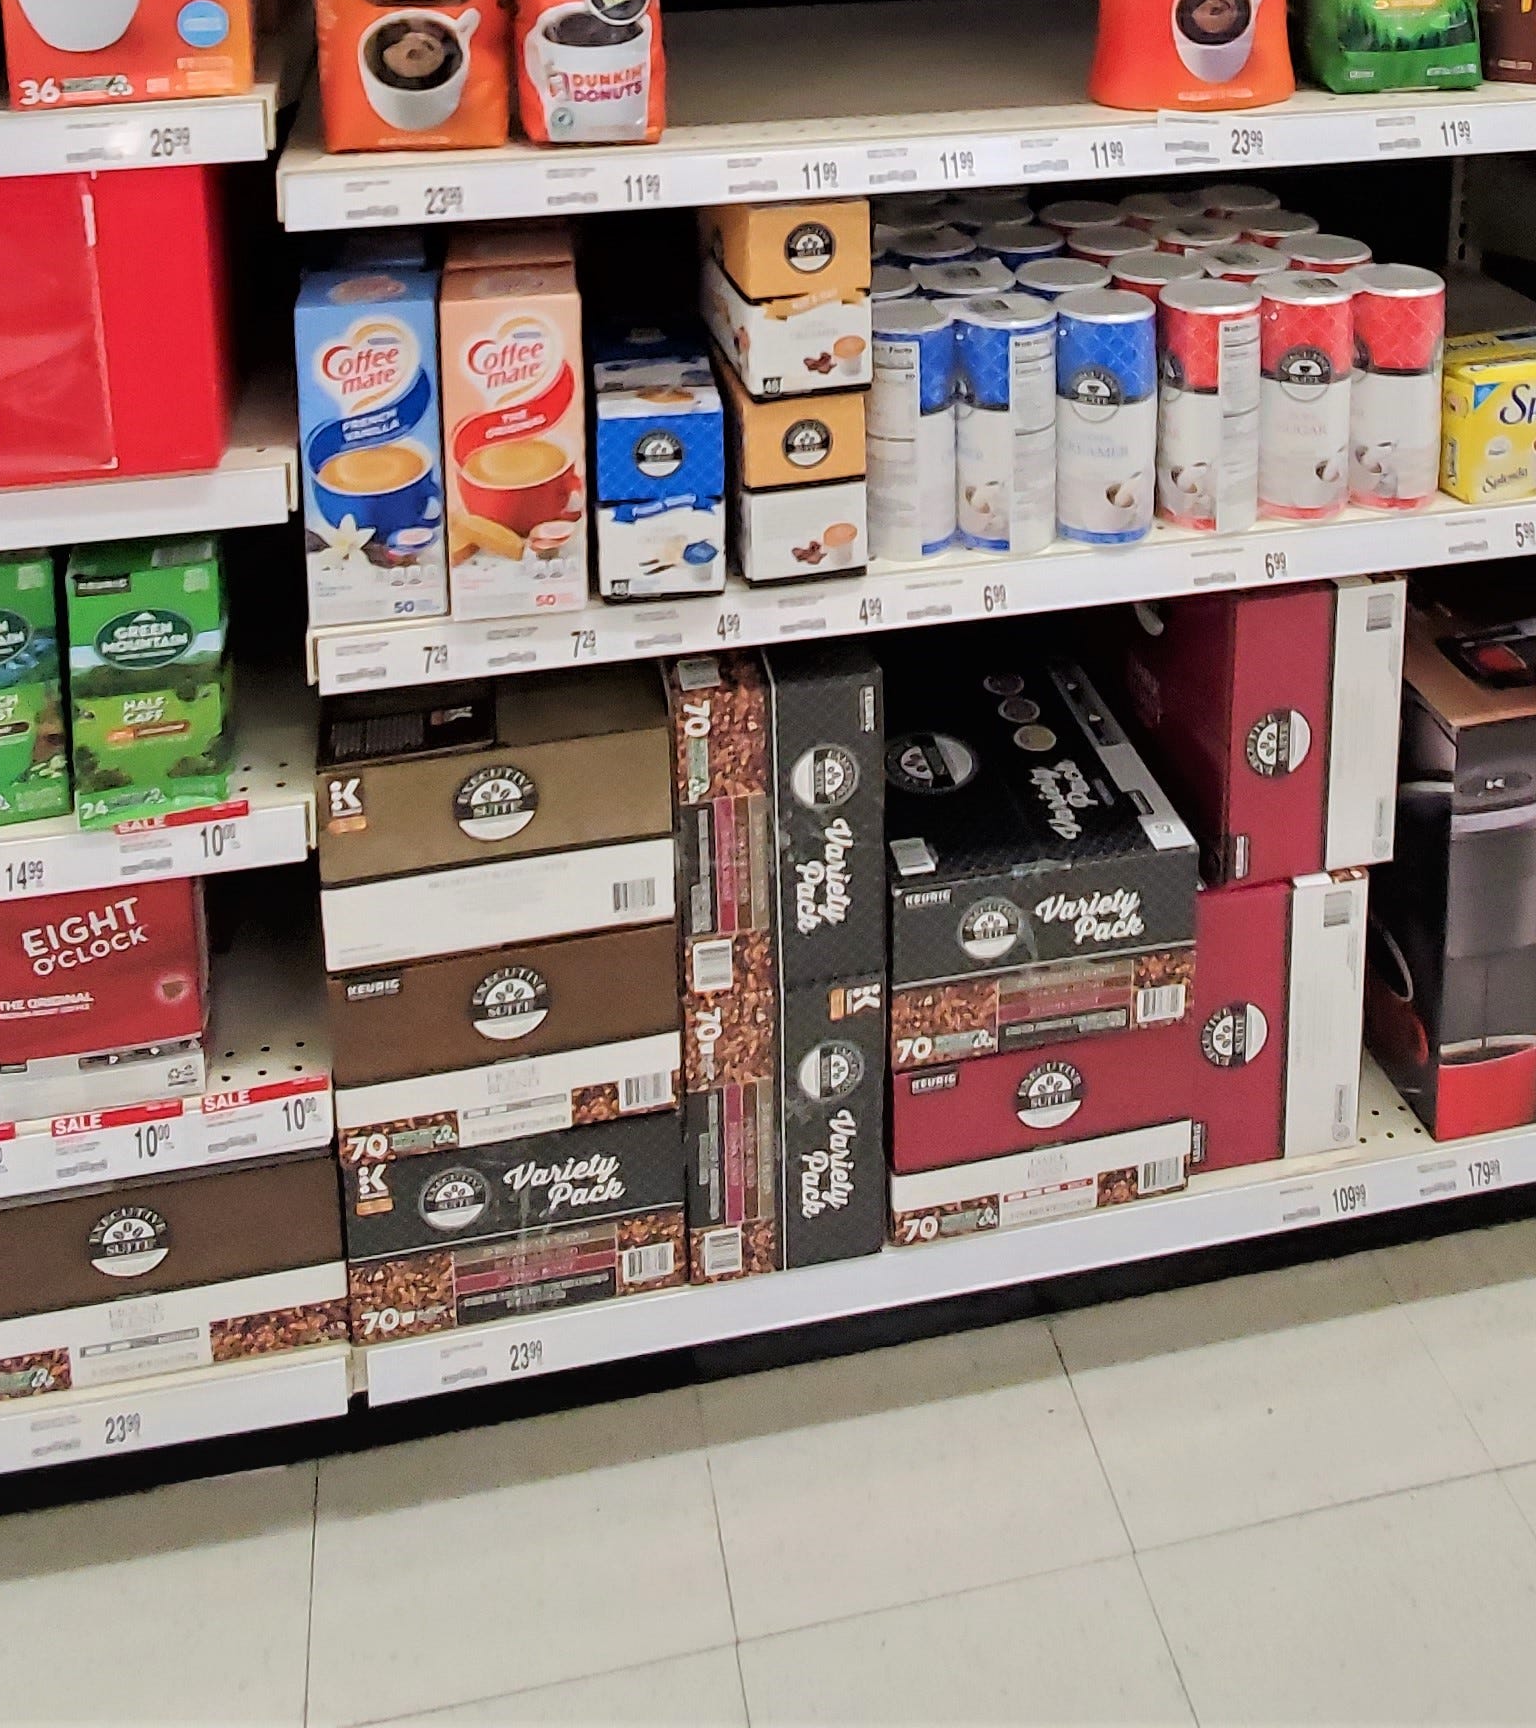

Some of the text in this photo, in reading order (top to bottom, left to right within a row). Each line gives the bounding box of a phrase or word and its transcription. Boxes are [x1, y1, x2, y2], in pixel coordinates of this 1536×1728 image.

[18, 78, 62, 105] 36
[322, 344, 400, 377] Coffee
[467, 340, 545, 375] Coffee
[341, 366, 399, 396] mate
[486, 362, 544, 391] mate
[123, 697, 166, 712] HALF
[818, 817, 854, 926] Variety
[795, 860, 826, 934] Pack
[1035, 888, 1141, 923] Variety
[21, 896, 140, 959] EIGHT
[1074, 912, 1145, 945] Pack
[32, 924, 149, 977] O'CLOCK
[204, 1090, 251, 1111] SALE
[55, 1112, 103, 1134] SALE
[347, 1133, 388, 1160] 70
[826, 1109, 859, 1212] Variety
[504, 1153, 620, 1190] Variety
[800, 1150, 830, 1219] Pack
[547, 1179, 626, 1212] Pack
[361, 1306, 399, 1334] 70
